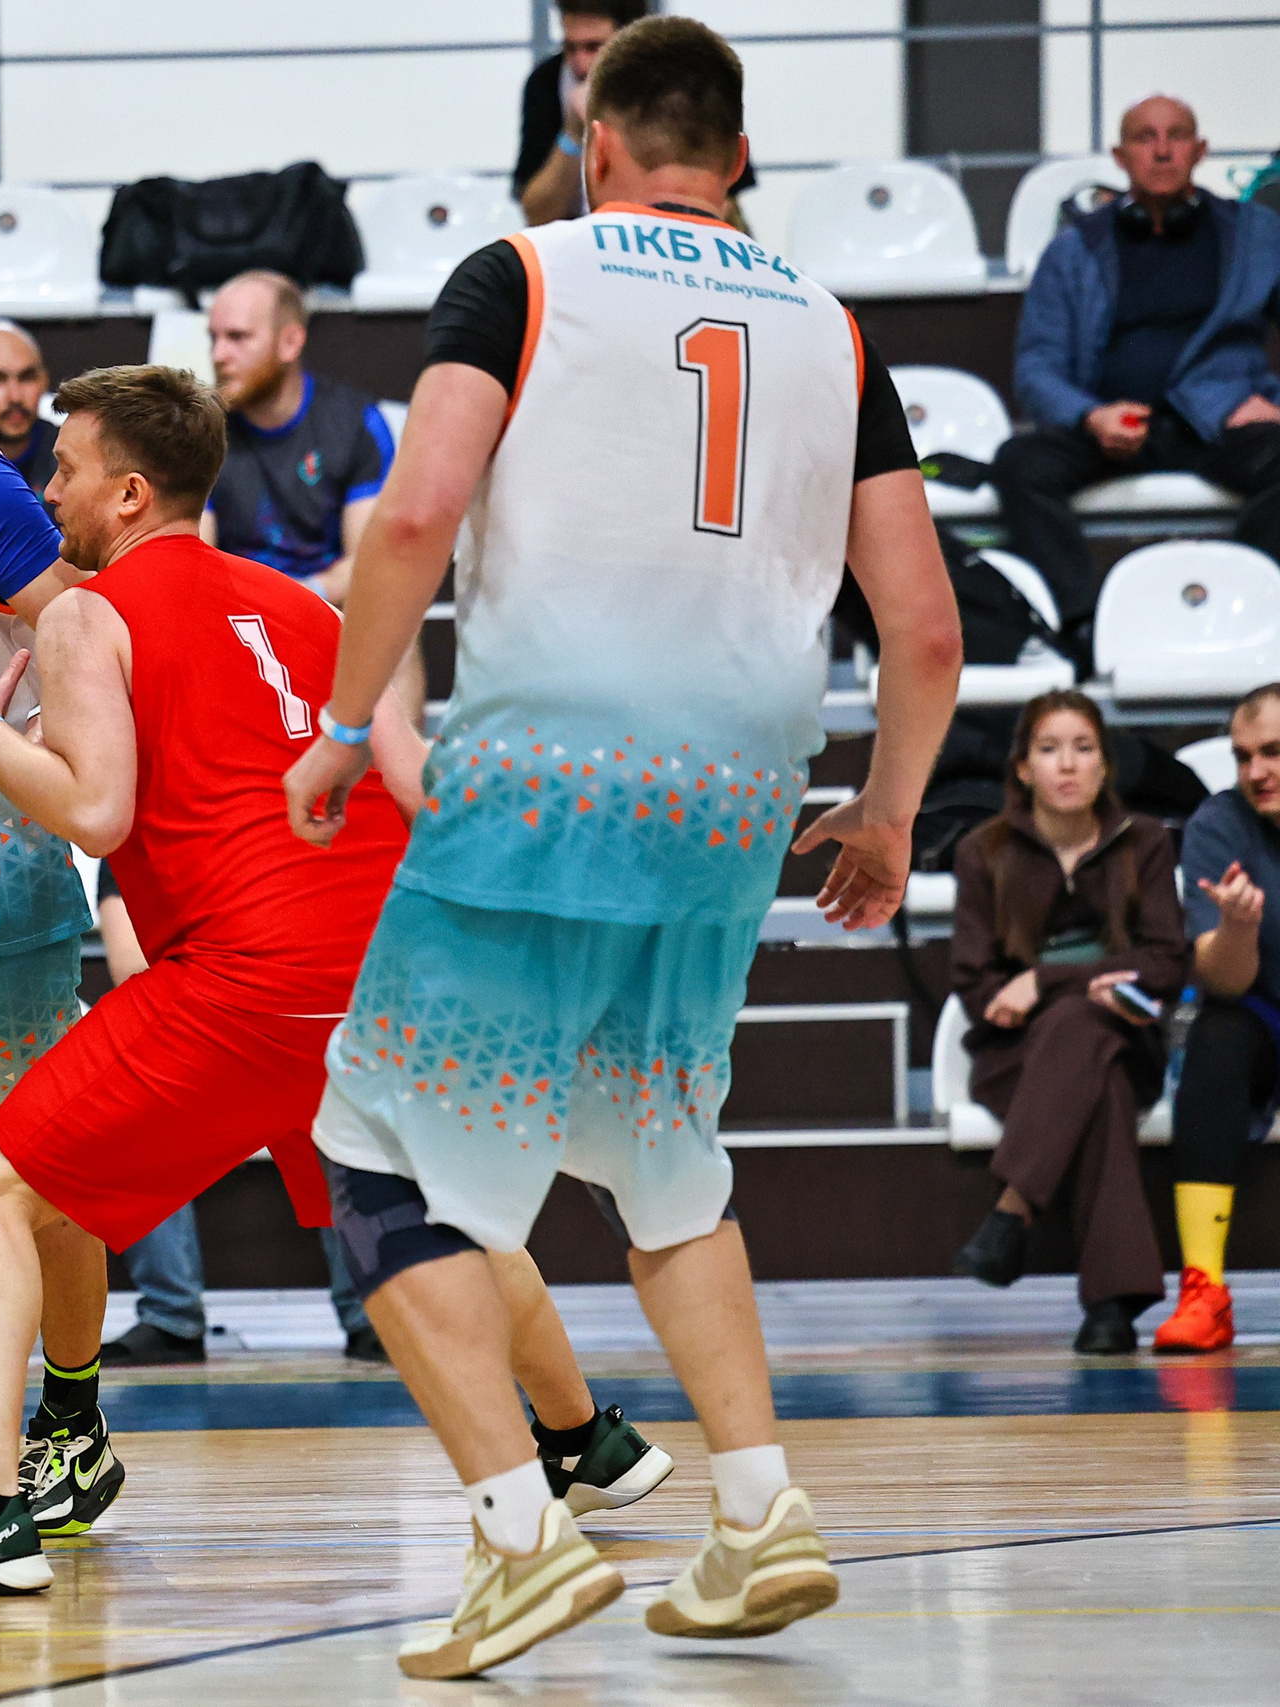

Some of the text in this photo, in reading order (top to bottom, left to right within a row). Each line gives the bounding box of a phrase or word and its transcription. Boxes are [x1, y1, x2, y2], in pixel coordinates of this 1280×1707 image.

[592, 224, 701, 263] ПКБ
[600, 262, 658, 282] имени
[676, 317, 750, 538] 1
[226, 614, 313, 740] 1
